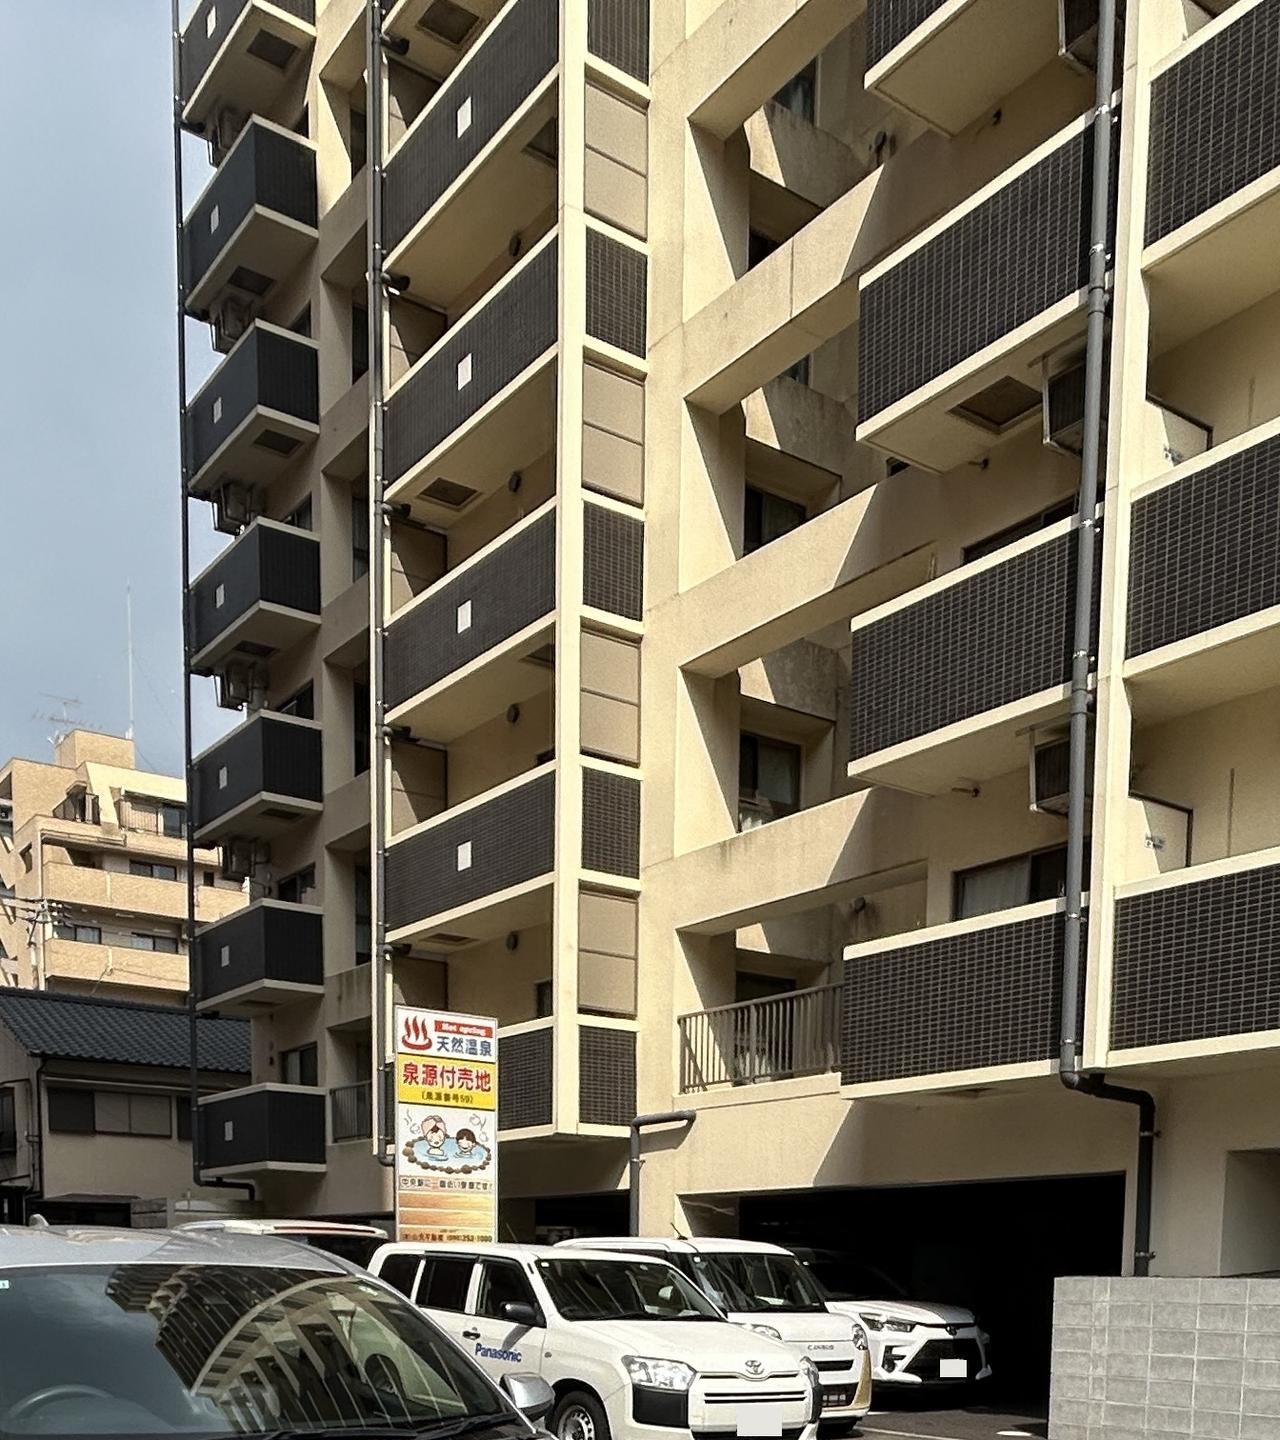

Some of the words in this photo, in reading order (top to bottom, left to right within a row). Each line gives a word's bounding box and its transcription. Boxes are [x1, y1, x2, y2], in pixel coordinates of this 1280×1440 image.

[436, 1035, 493, 1057] 天然温泉
[402, 1061, 492, 1093] 泉源付売地
[475, 1343, 522, 1362] Panasonic
